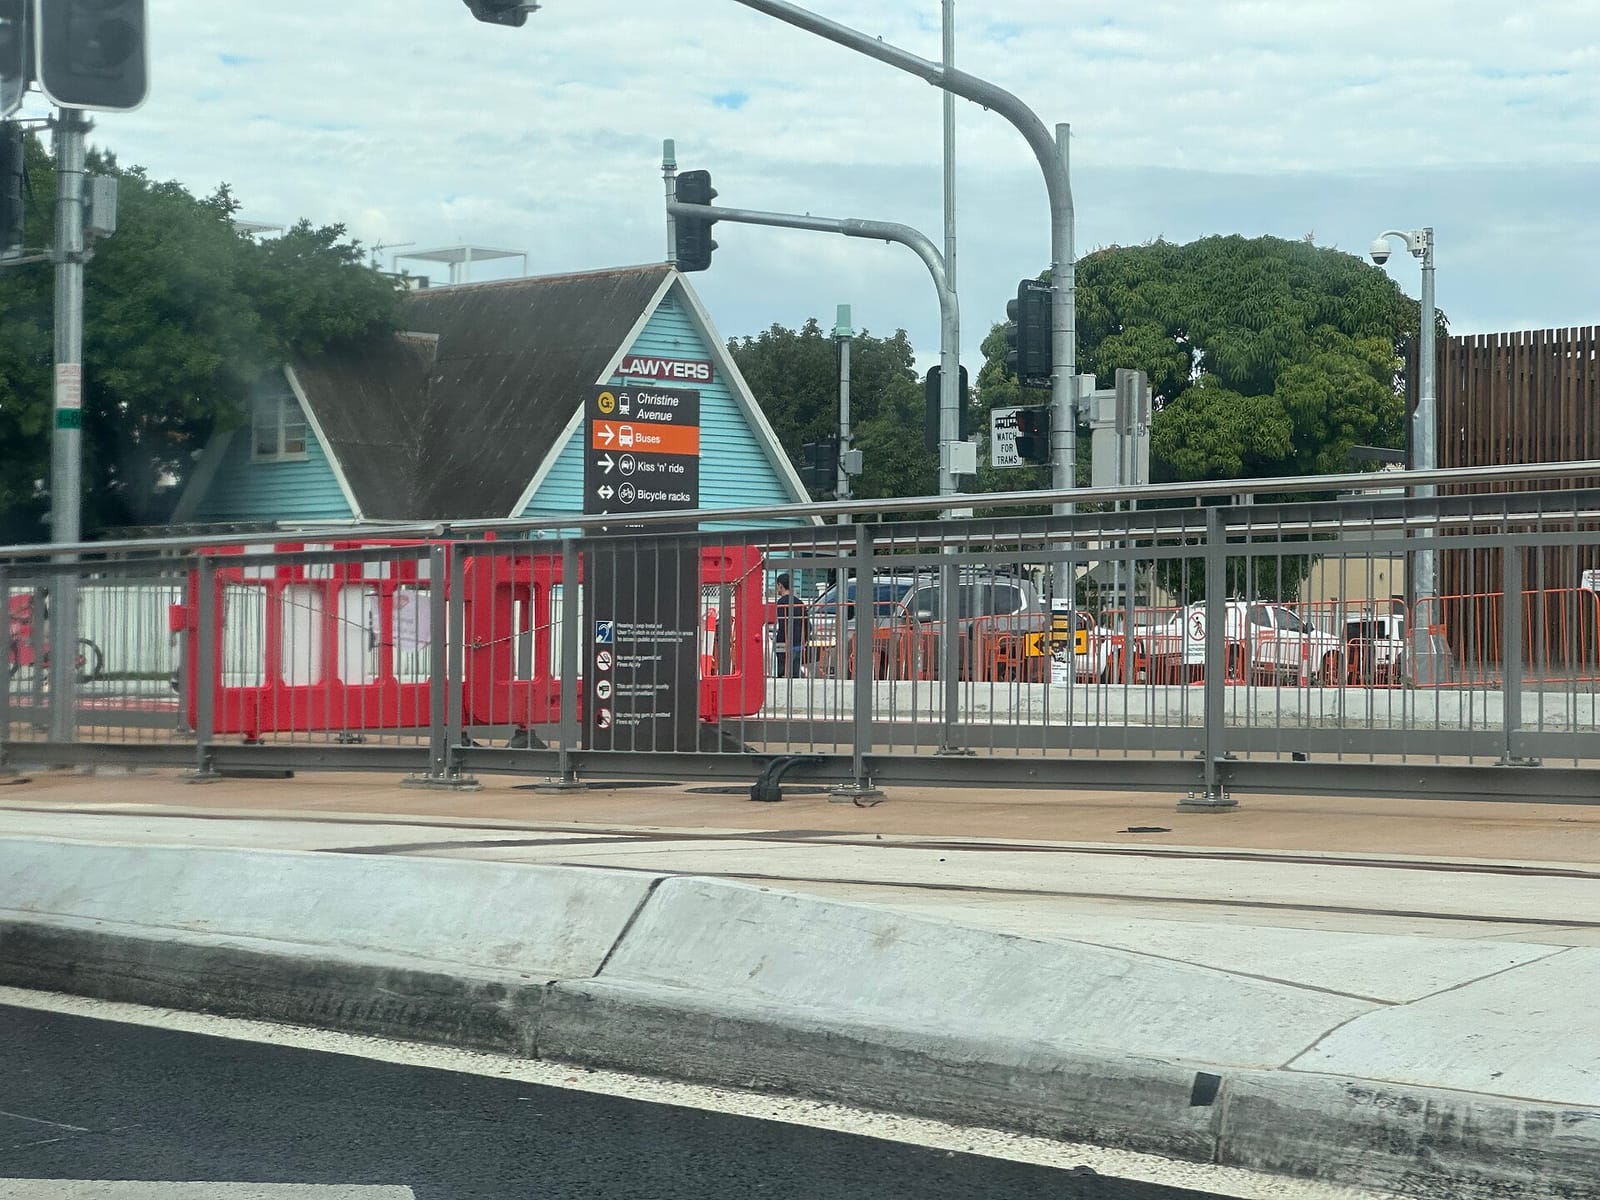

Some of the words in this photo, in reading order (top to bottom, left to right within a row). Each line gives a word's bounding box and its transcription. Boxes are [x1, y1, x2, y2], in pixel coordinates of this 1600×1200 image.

[619, 359, 709, 379] LAWYERS
[637, 392, 679, 407] Christine
[636, 408, 673, 421] Avenue
[635, 432, 661, 444] Buses
[997, 432, 1017, 441] WATCH
[1001, 443, 1013, 453] FOR
[997, 455, 1018, 465] TRAMS
[637, 461, 655, 472] Kiss
[669, 463, 684, 474] ride
[637, 489, 667, 502] Bicycle
[668, 492, 691, 502] racks
